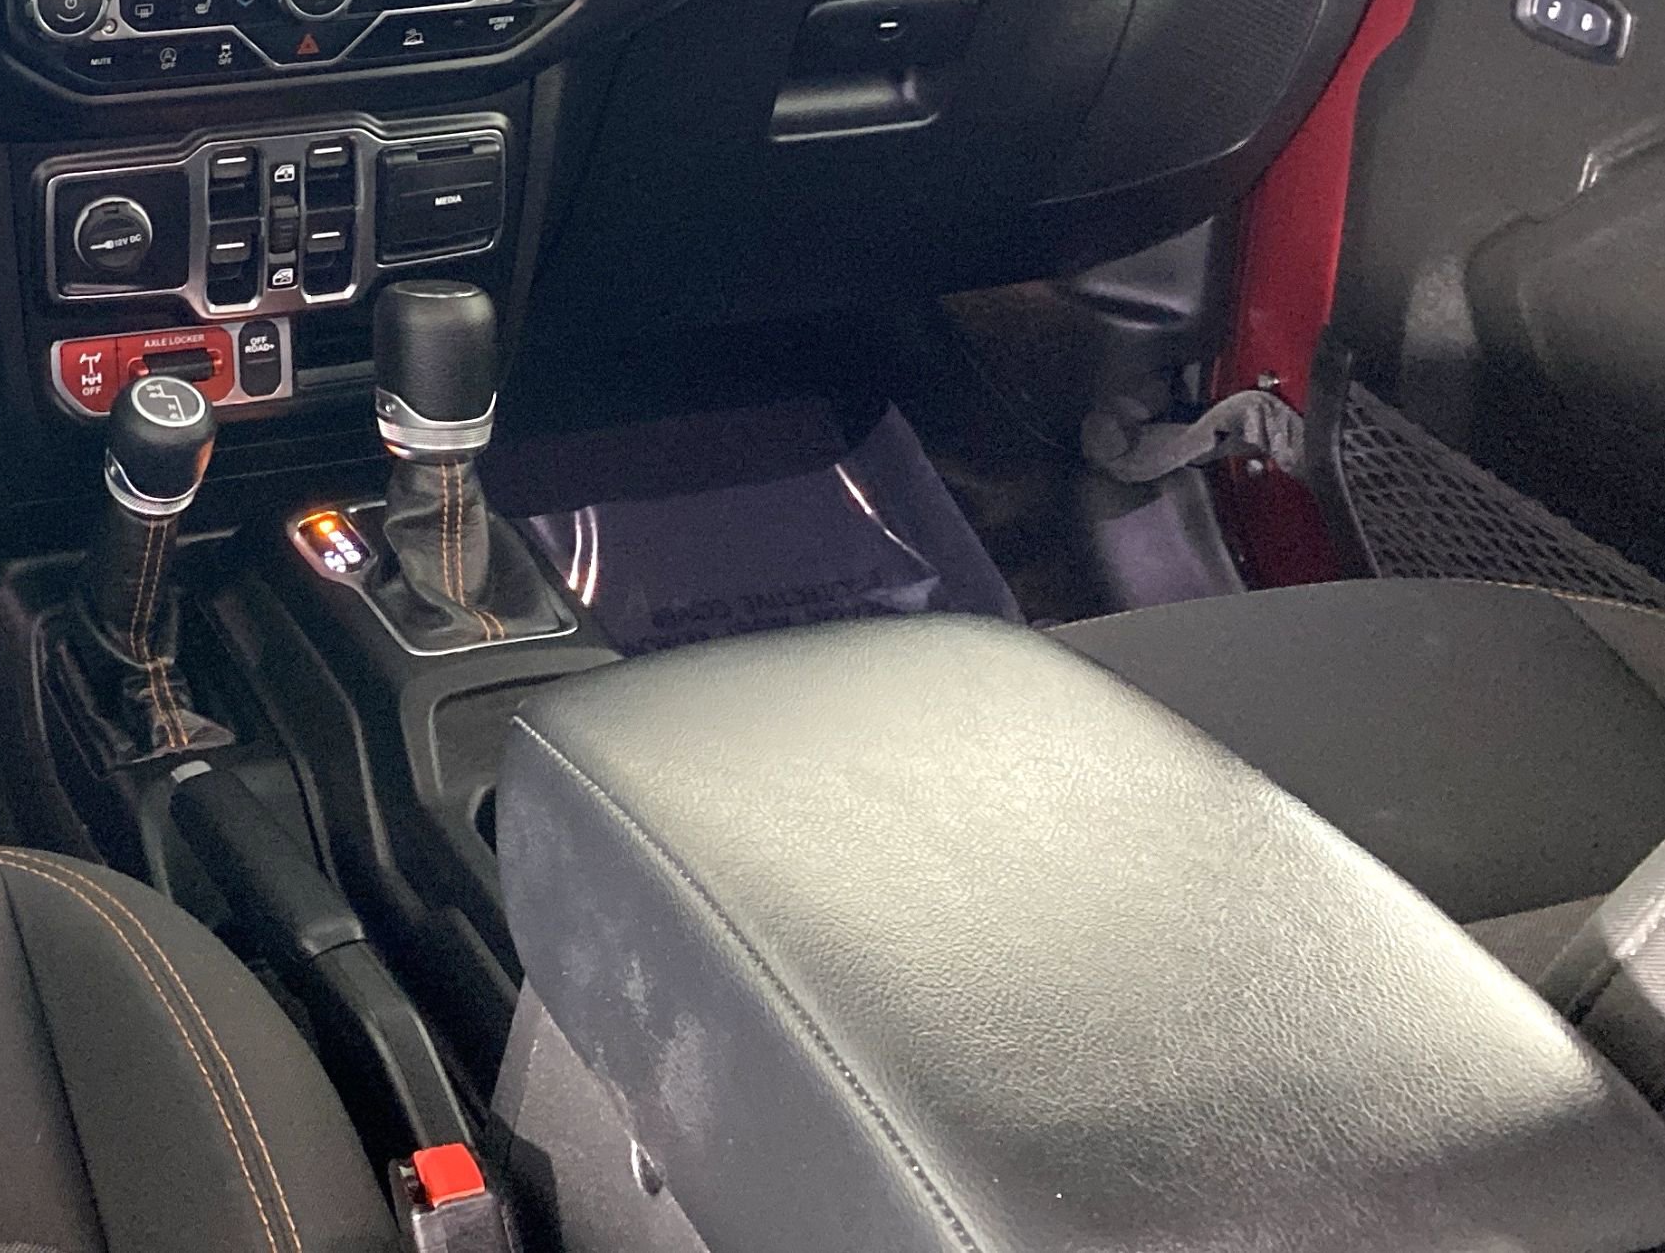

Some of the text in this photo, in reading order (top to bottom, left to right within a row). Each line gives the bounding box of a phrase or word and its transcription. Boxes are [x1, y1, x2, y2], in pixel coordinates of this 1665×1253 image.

[488, 15, 515, 26] SCREEN
[492, 22, 508, 31] OFF
[90, 56, 112, 66] MUTE
[161, 61, 176, 71] OFF
[217, 56, 233, 66] OFF
[434, 194, 462, 207] MEDIA
[129, 233, 143, 244] DC
[143, 333, 206, 348] AXLE LOCKER
[249, 335, 268, 346] OFF
[82, 385, 102, 396] OFF
